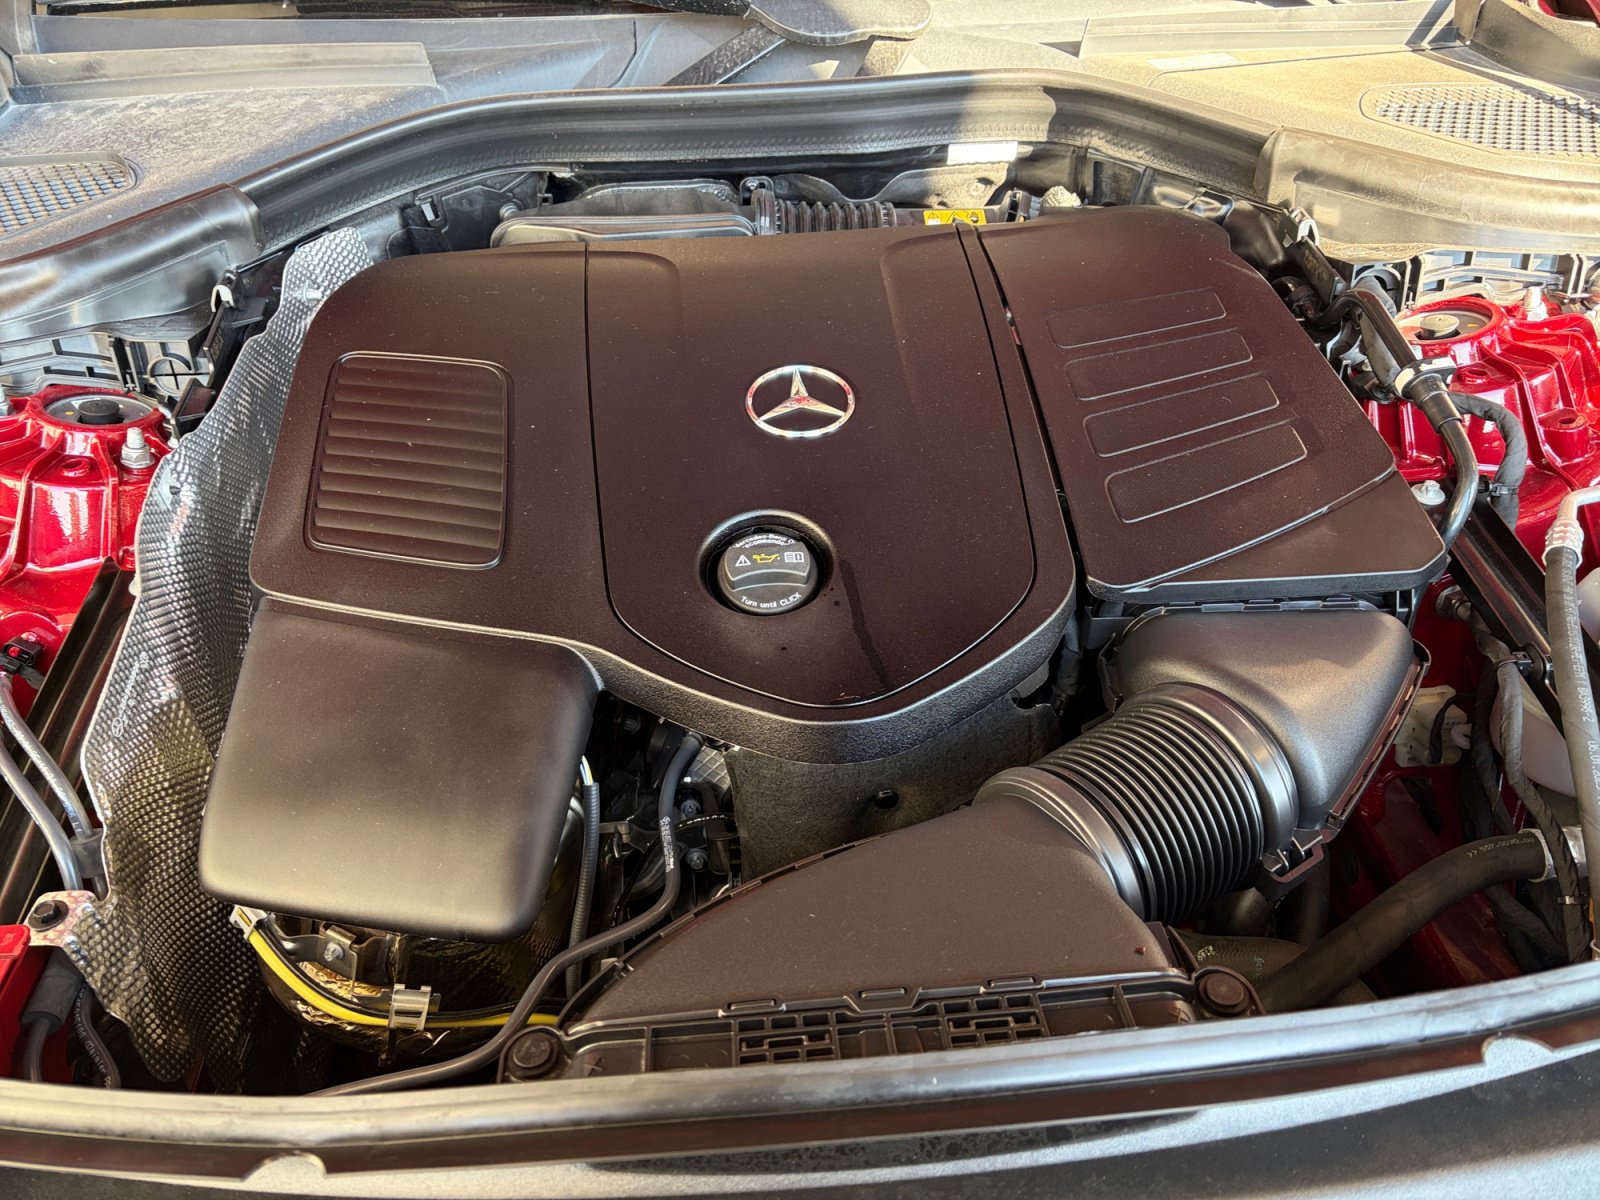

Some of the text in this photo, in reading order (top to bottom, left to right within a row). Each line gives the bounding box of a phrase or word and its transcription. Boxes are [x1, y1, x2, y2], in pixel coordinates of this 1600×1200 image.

[741, 591, 802, 609] Turn until CLICK
